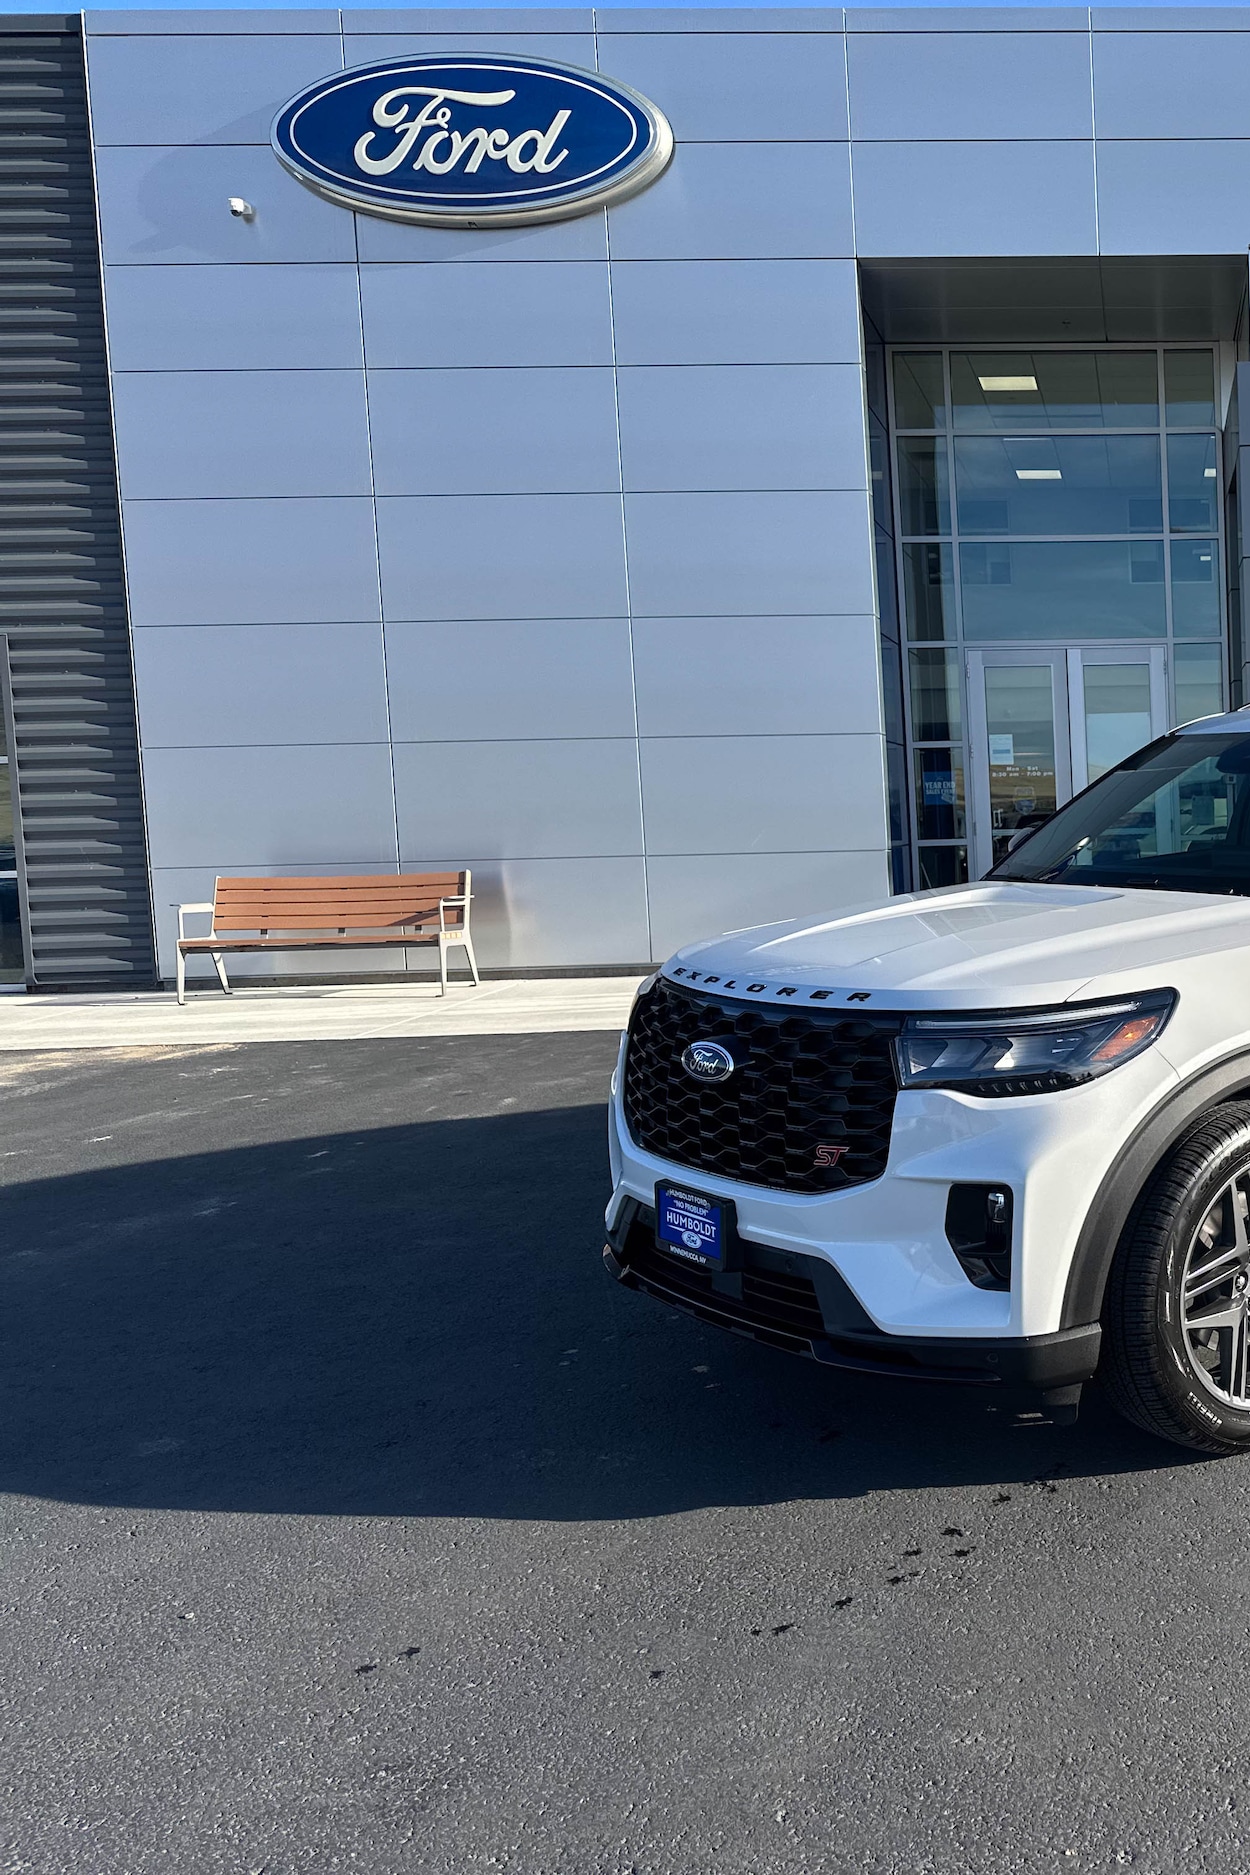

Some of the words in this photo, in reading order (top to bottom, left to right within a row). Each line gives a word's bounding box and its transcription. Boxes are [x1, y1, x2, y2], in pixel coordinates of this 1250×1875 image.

[353, 86, 572, 176] Ford
[925, 781, 942, 789] YEAR
[943, 781, 956, 789] END
[672, 966, 872, 1002] EXPLORER
[813, 1145, 849, 1167] ST
[669, 1189, 694, 1202] HUMBOLDT
[666, 1211, 716, 1237] HUMBOLDT
